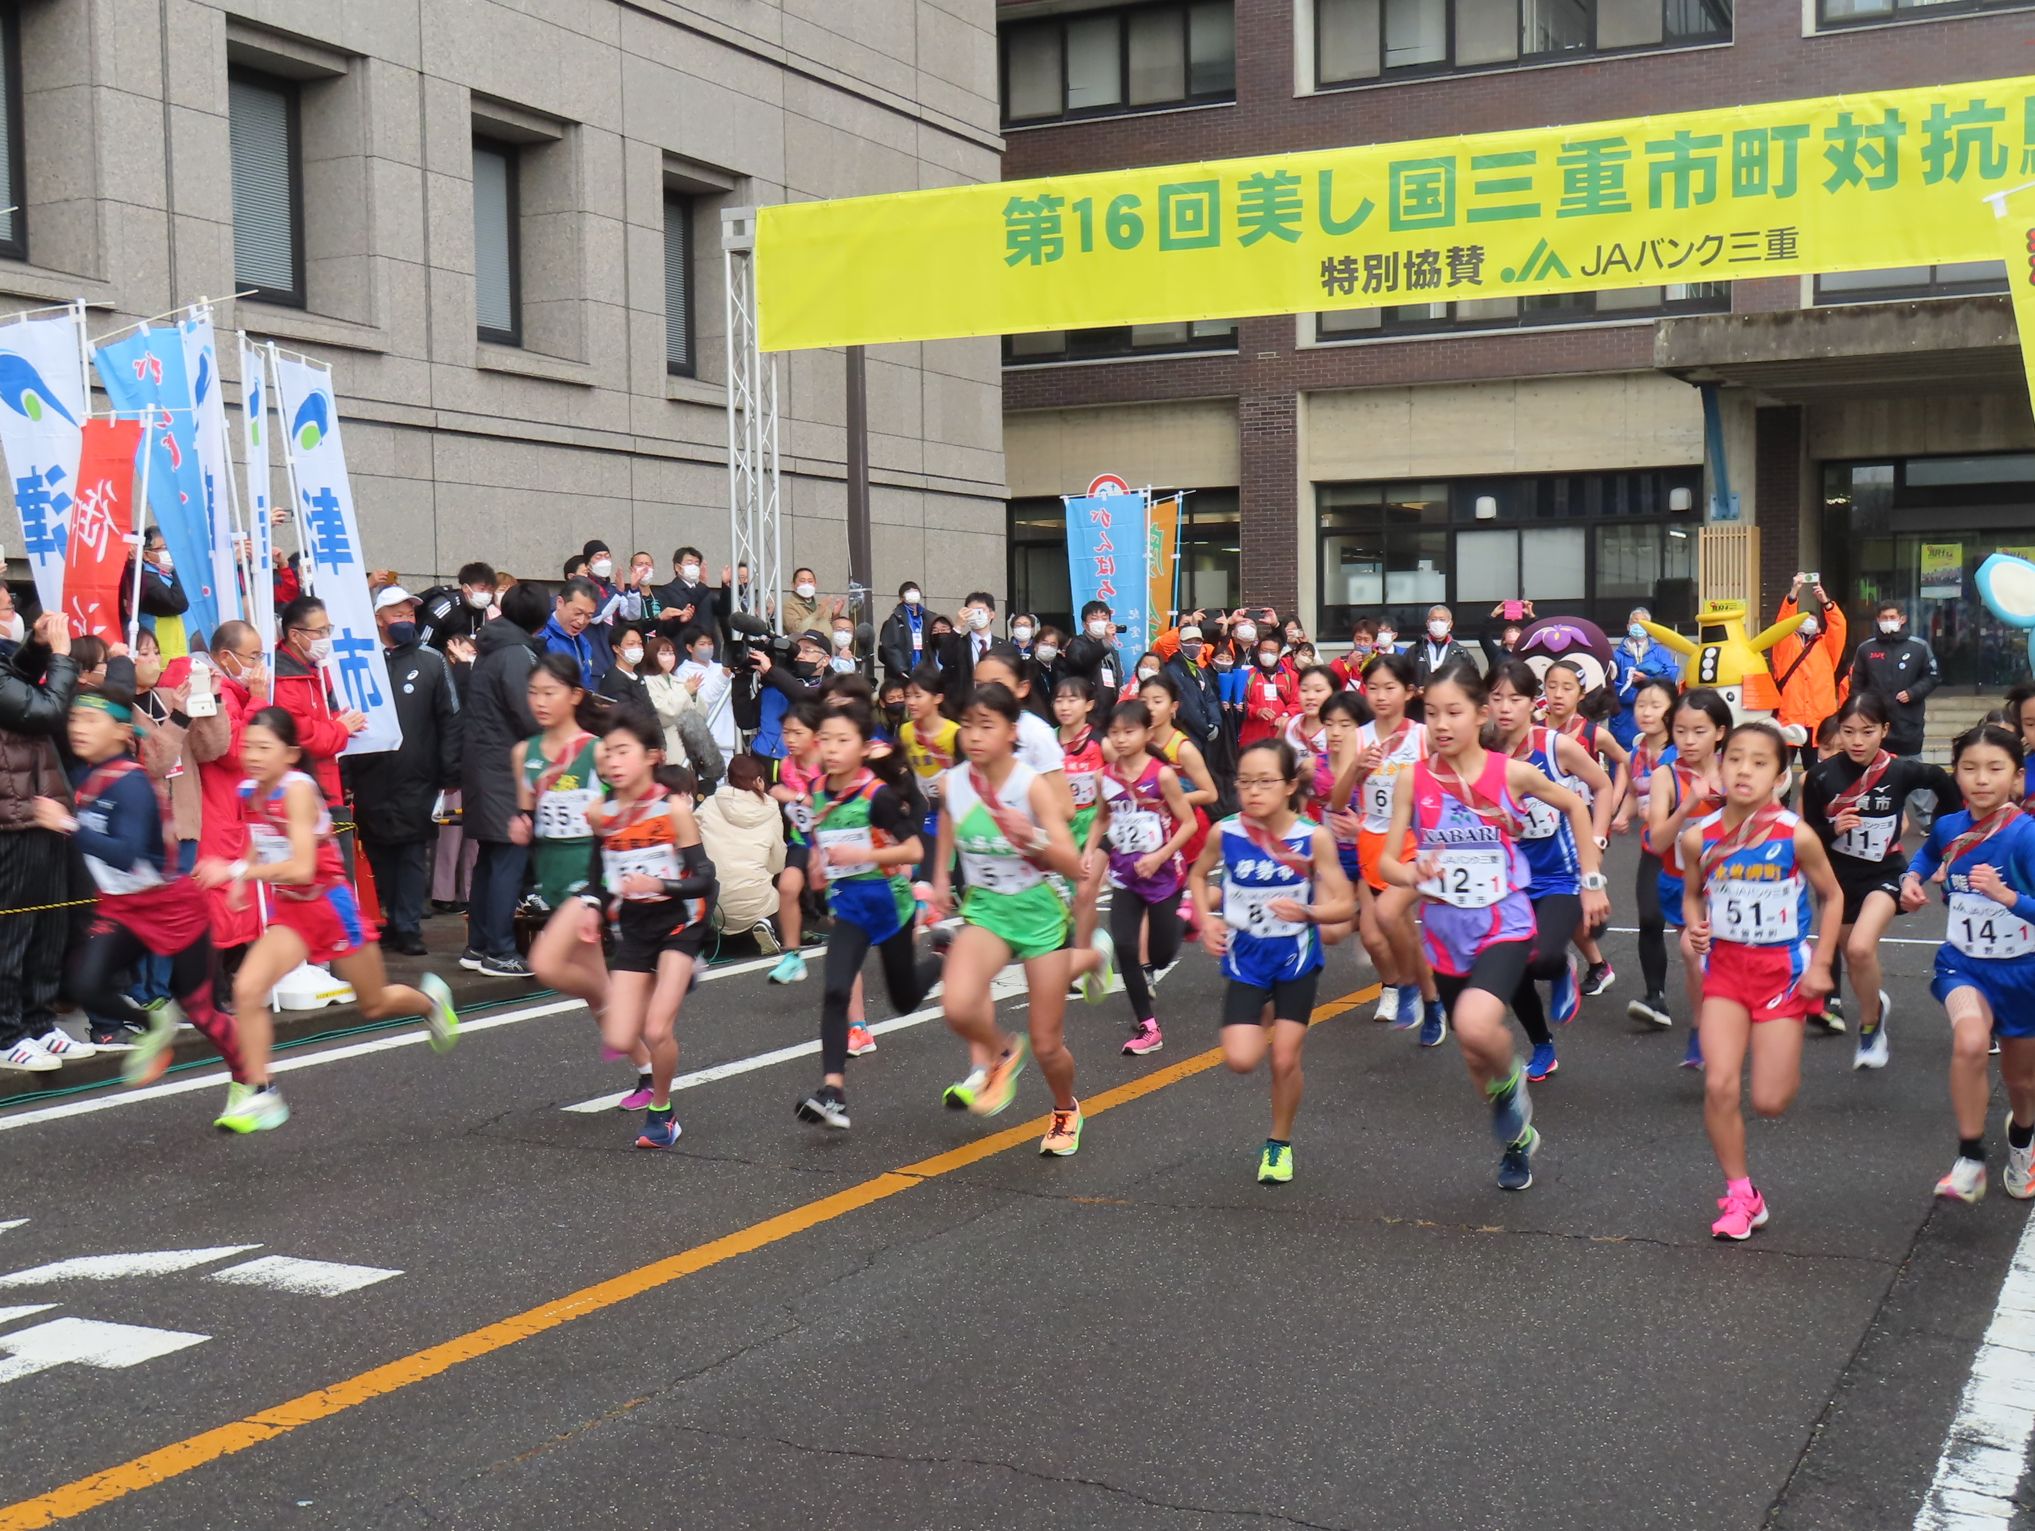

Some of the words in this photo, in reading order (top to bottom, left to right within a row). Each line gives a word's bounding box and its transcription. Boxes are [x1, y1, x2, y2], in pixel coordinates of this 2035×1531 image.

[1320, 245, 1484, 296] 特別協賛
[1580, 226, 1800, 277] JAバンク三重
[1727, 898, 1787, 927] 51-1
[1961, 917, 2030, 945] 14-1
